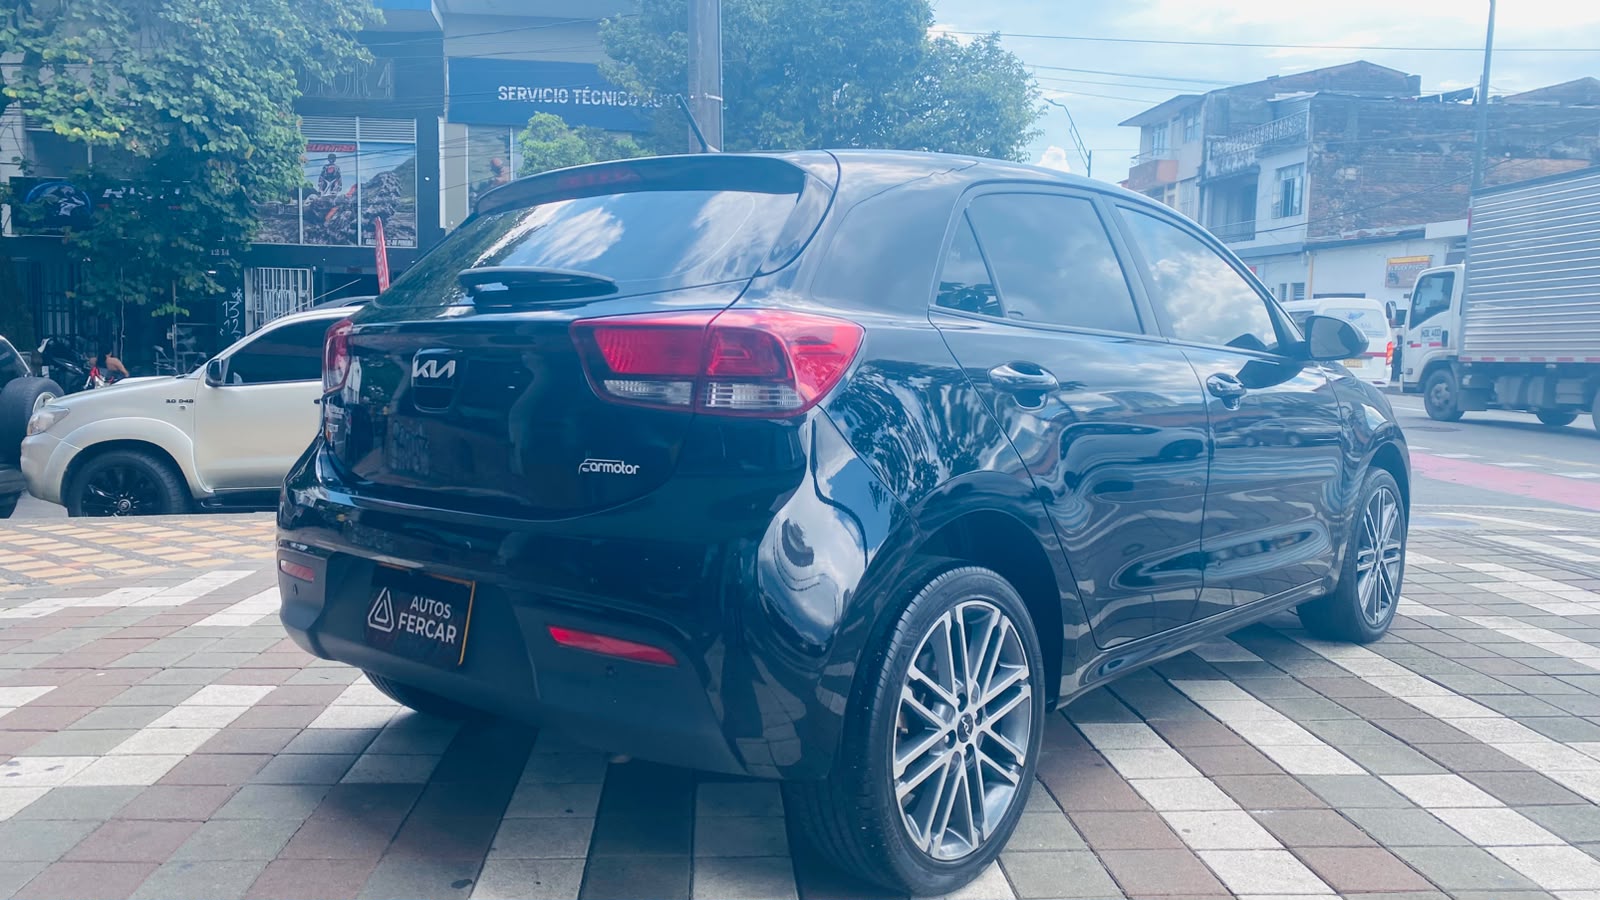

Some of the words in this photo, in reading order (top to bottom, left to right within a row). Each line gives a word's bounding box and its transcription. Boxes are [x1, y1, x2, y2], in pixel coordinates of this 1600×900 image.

[498, 86, 568, 104] SERVICIO
[572, 86, 638, 106] TÉCNICO
[412, 359, 456, 378] KIA
[410, 596, 451, 619] AUTOS
[398, 612, 457, 644] FERCAR
